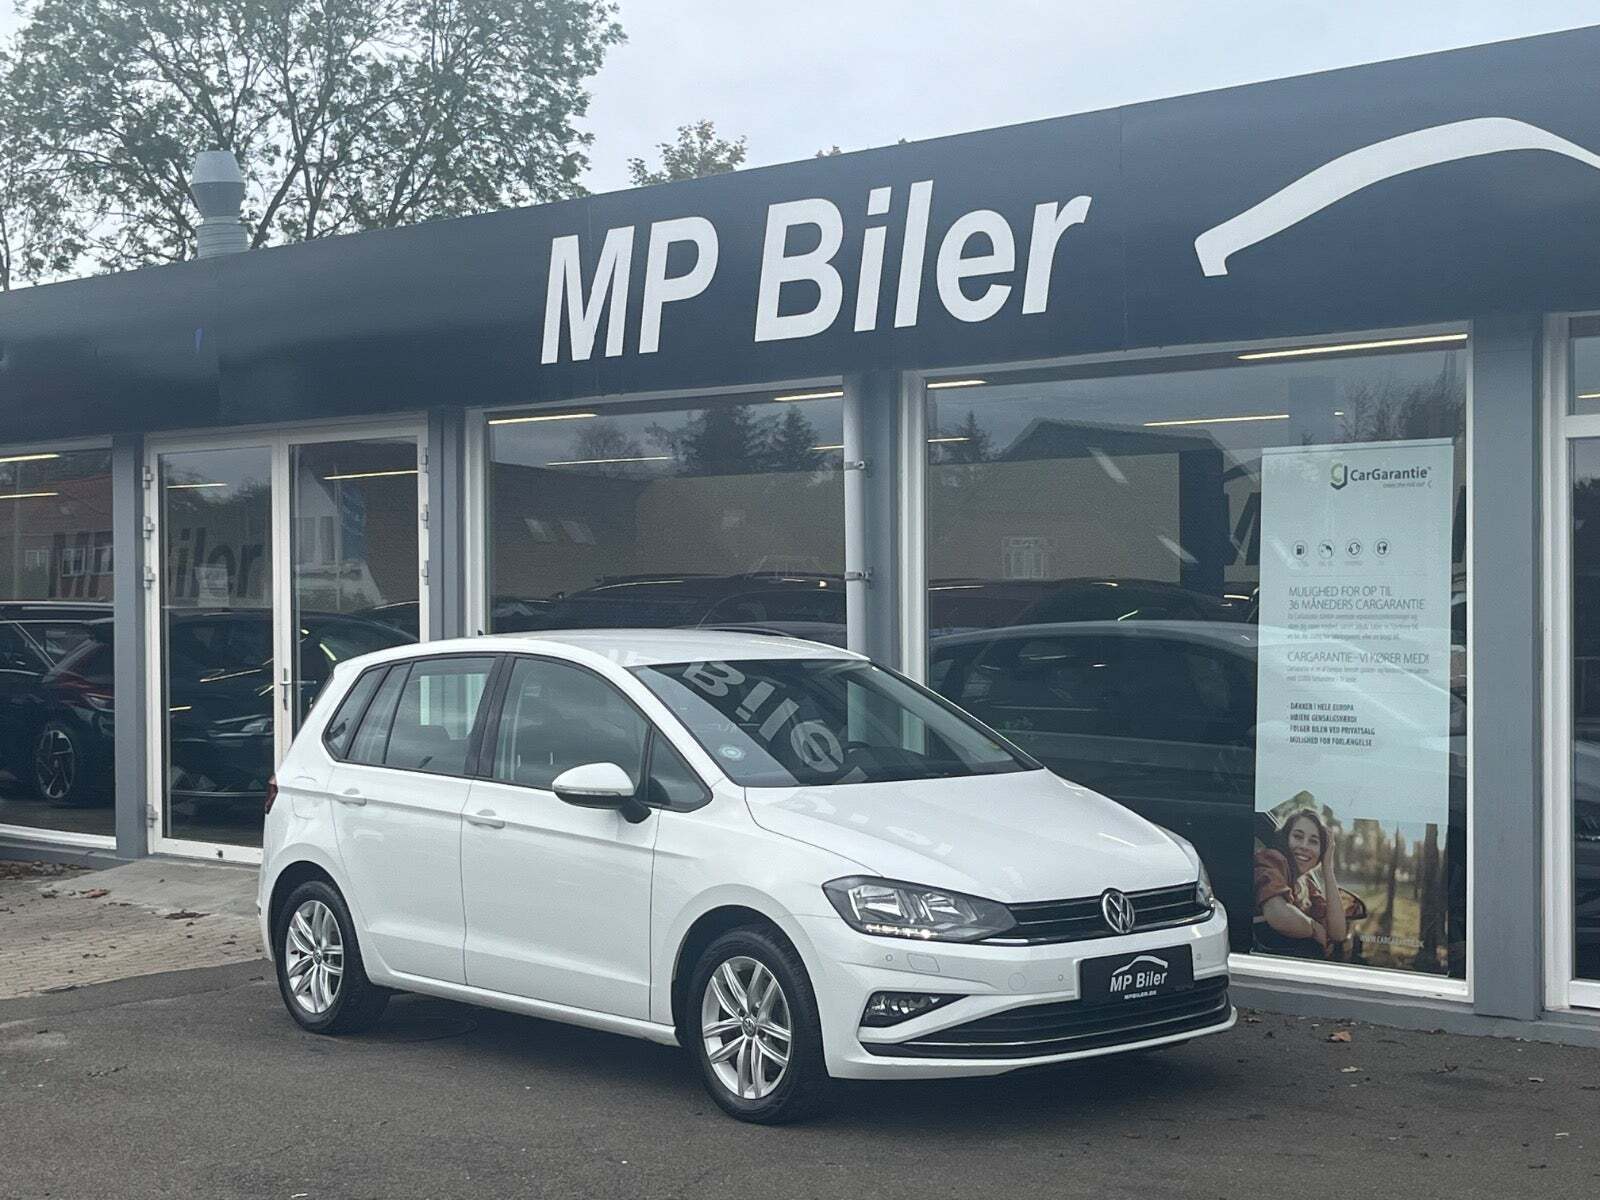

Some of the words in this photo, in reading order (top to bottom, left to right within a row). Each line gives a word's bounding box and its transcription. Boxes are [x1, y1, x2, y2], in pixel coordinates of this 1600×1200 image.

[541, 216, 719, 364] MP
[755, 180, 1092, 342] Biler
[1350, 466, 1428, 481] CarGarantie
[1289, 586, 1338, 597] MULIGHED
[1341, 586, 1359, 597] FOR
[1362, 586, 1377, 597] OP
[1380, 586, 1393, 597] TIL
[1289, 600, 1299, 610] 36
[1301, 598, 1353, 610] MÅNEDERS
[1356, 599, 1425, 610] CARGARANTIE
[1287, 651, 1352, 663] CARGARANTIE
[1403, 653, 1429, 664] MED!
[1332, 703, 1354, 711] EUROPA
[1329, 726, 1340, 734] VED
[1341, 726, 1375, 735] PRIVATSALG
[1320, 737, 1330, 745] FOR
[1332, 737, 1372, 746] FORLÆNGELSE
[1110, 975, 1132, 992] MP
[1136, 971, 1168, 988] Biler
